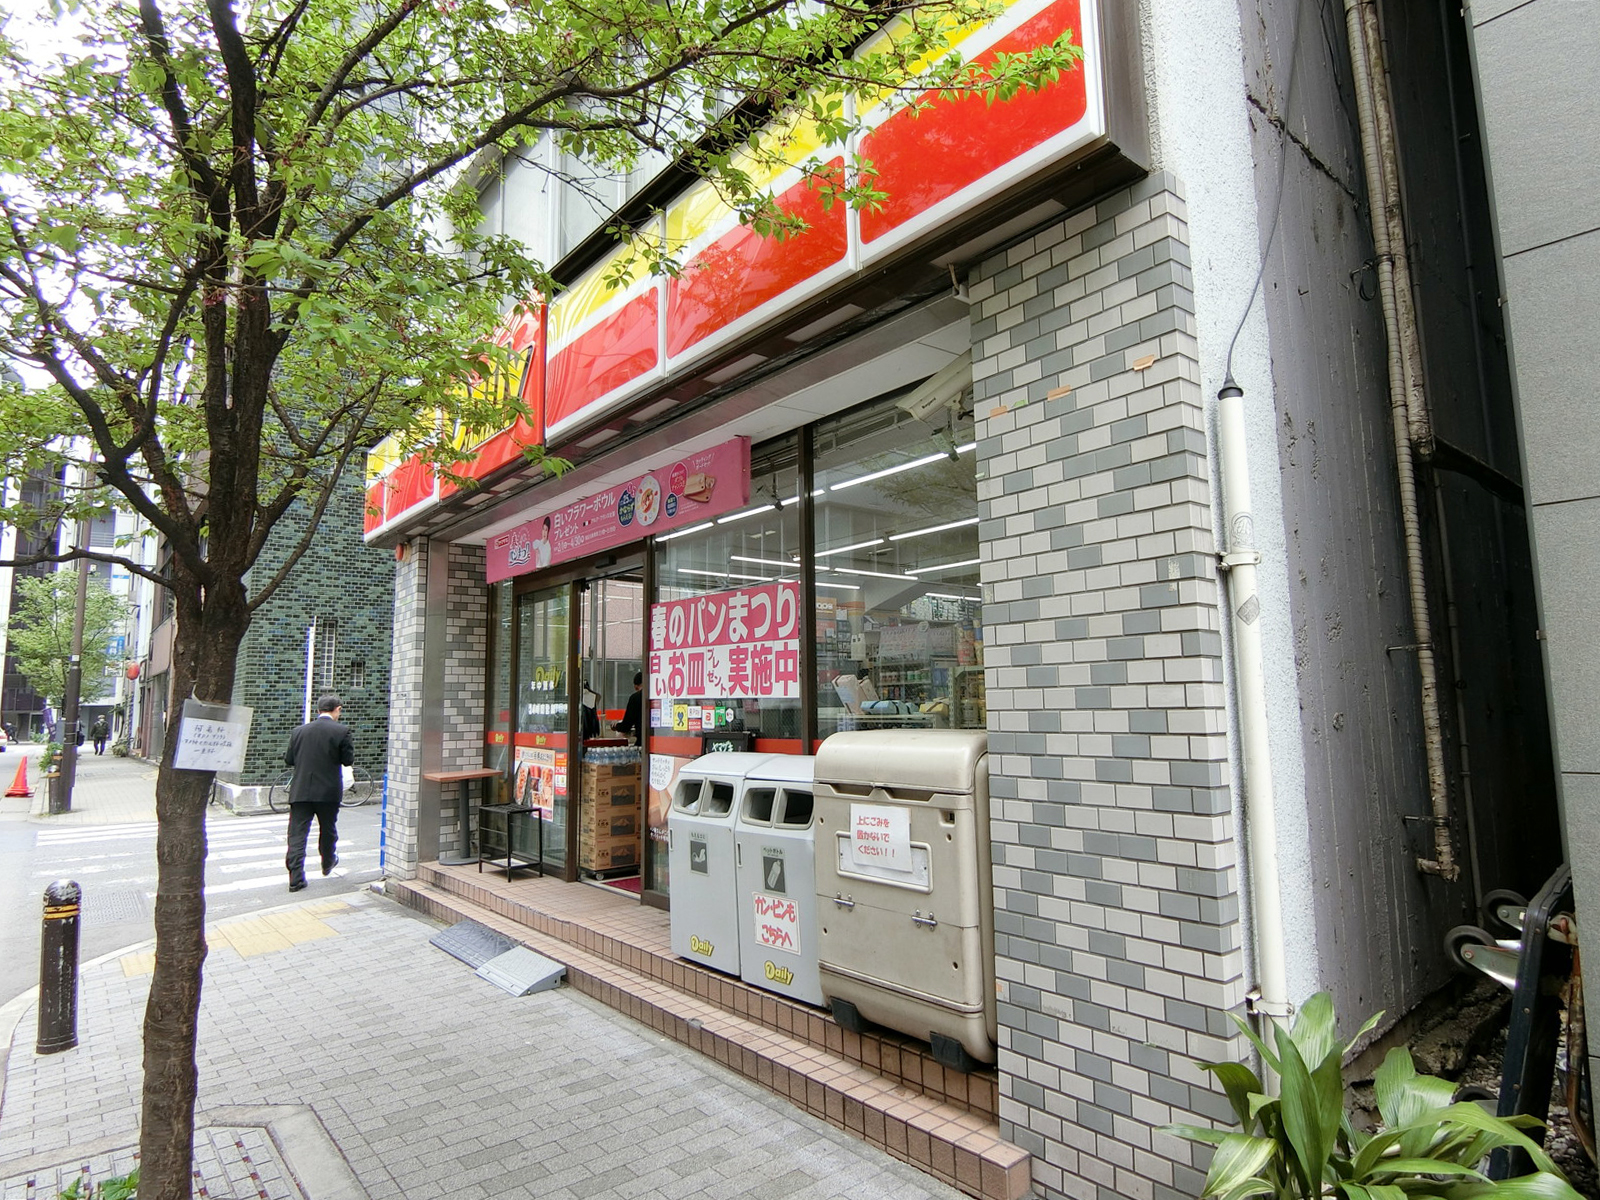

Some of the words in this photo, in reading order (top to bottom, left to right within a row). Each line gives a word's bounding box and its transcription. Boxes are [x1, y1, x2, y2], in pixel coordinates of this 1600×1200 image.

[554, 492, 616, 528] 白いフラワーボウル
[651, 585, 797, 649] 春のパンまつり
[857, 815, 890, 828] 上にごみを
[857, 830, 890, 842] 置かないで
[690, 934, 714, 957] Daily
[761, 924, 793, 948] こちらへ
[764, 959, 794, 986] Daily
